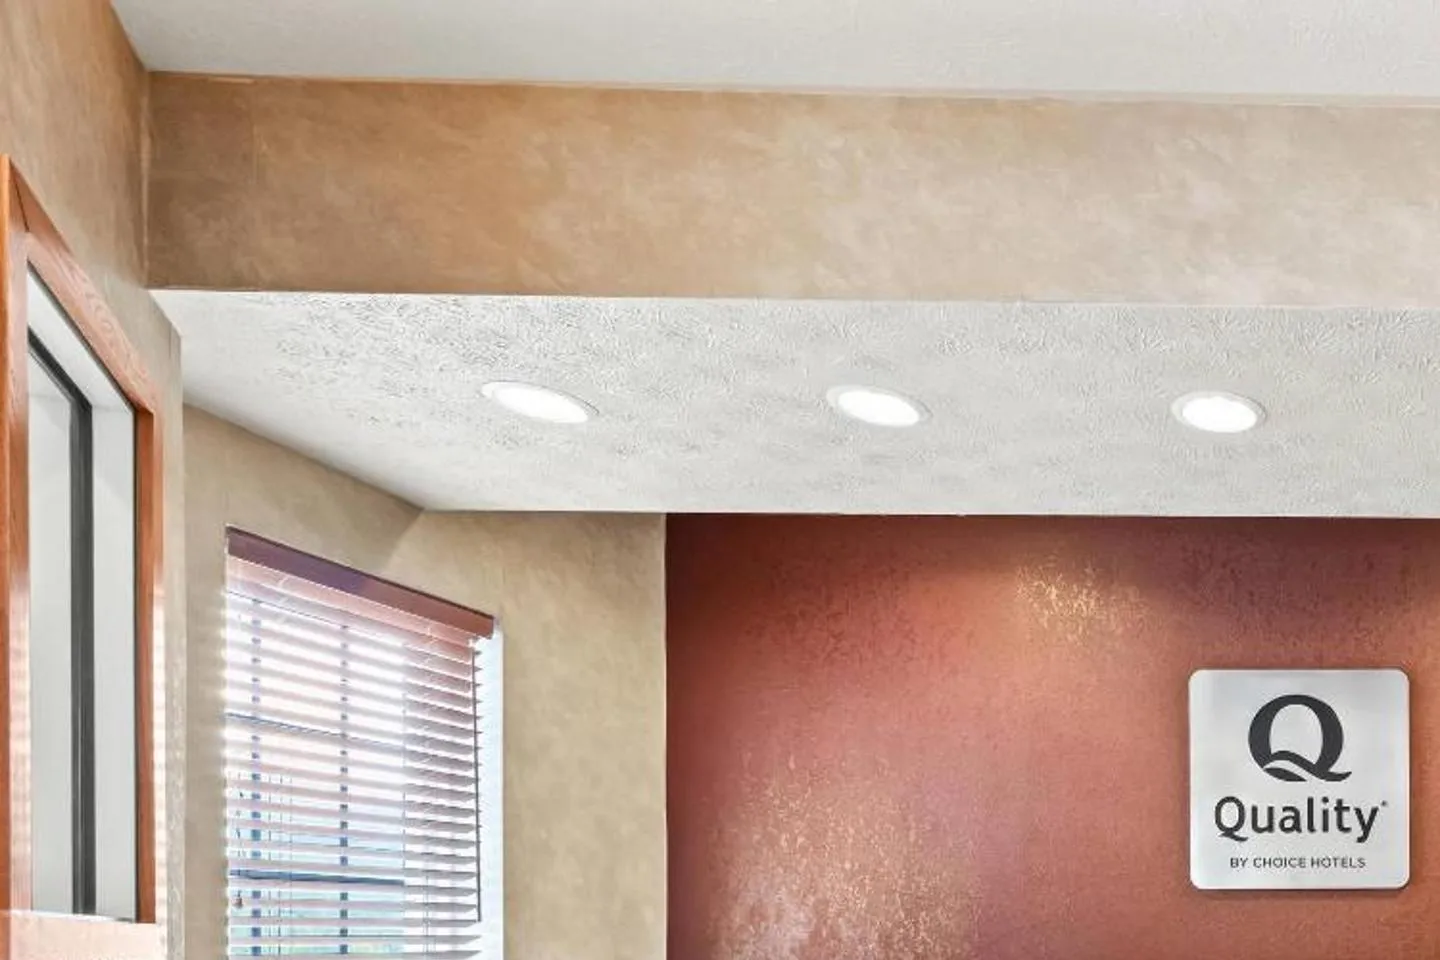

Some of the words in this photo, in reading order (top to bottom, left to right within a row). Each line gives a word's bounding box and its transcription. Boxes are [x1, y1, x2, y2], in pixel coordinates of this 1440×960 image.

[1247, 694, 1353, 783] Q
[1214, 796, 1380, 843] Quality
[1230, 857, 1248, 868] BY
[1252, 857, 1306, 868] CHOICE
[1311, 857, 1366, 868] HOTELS
